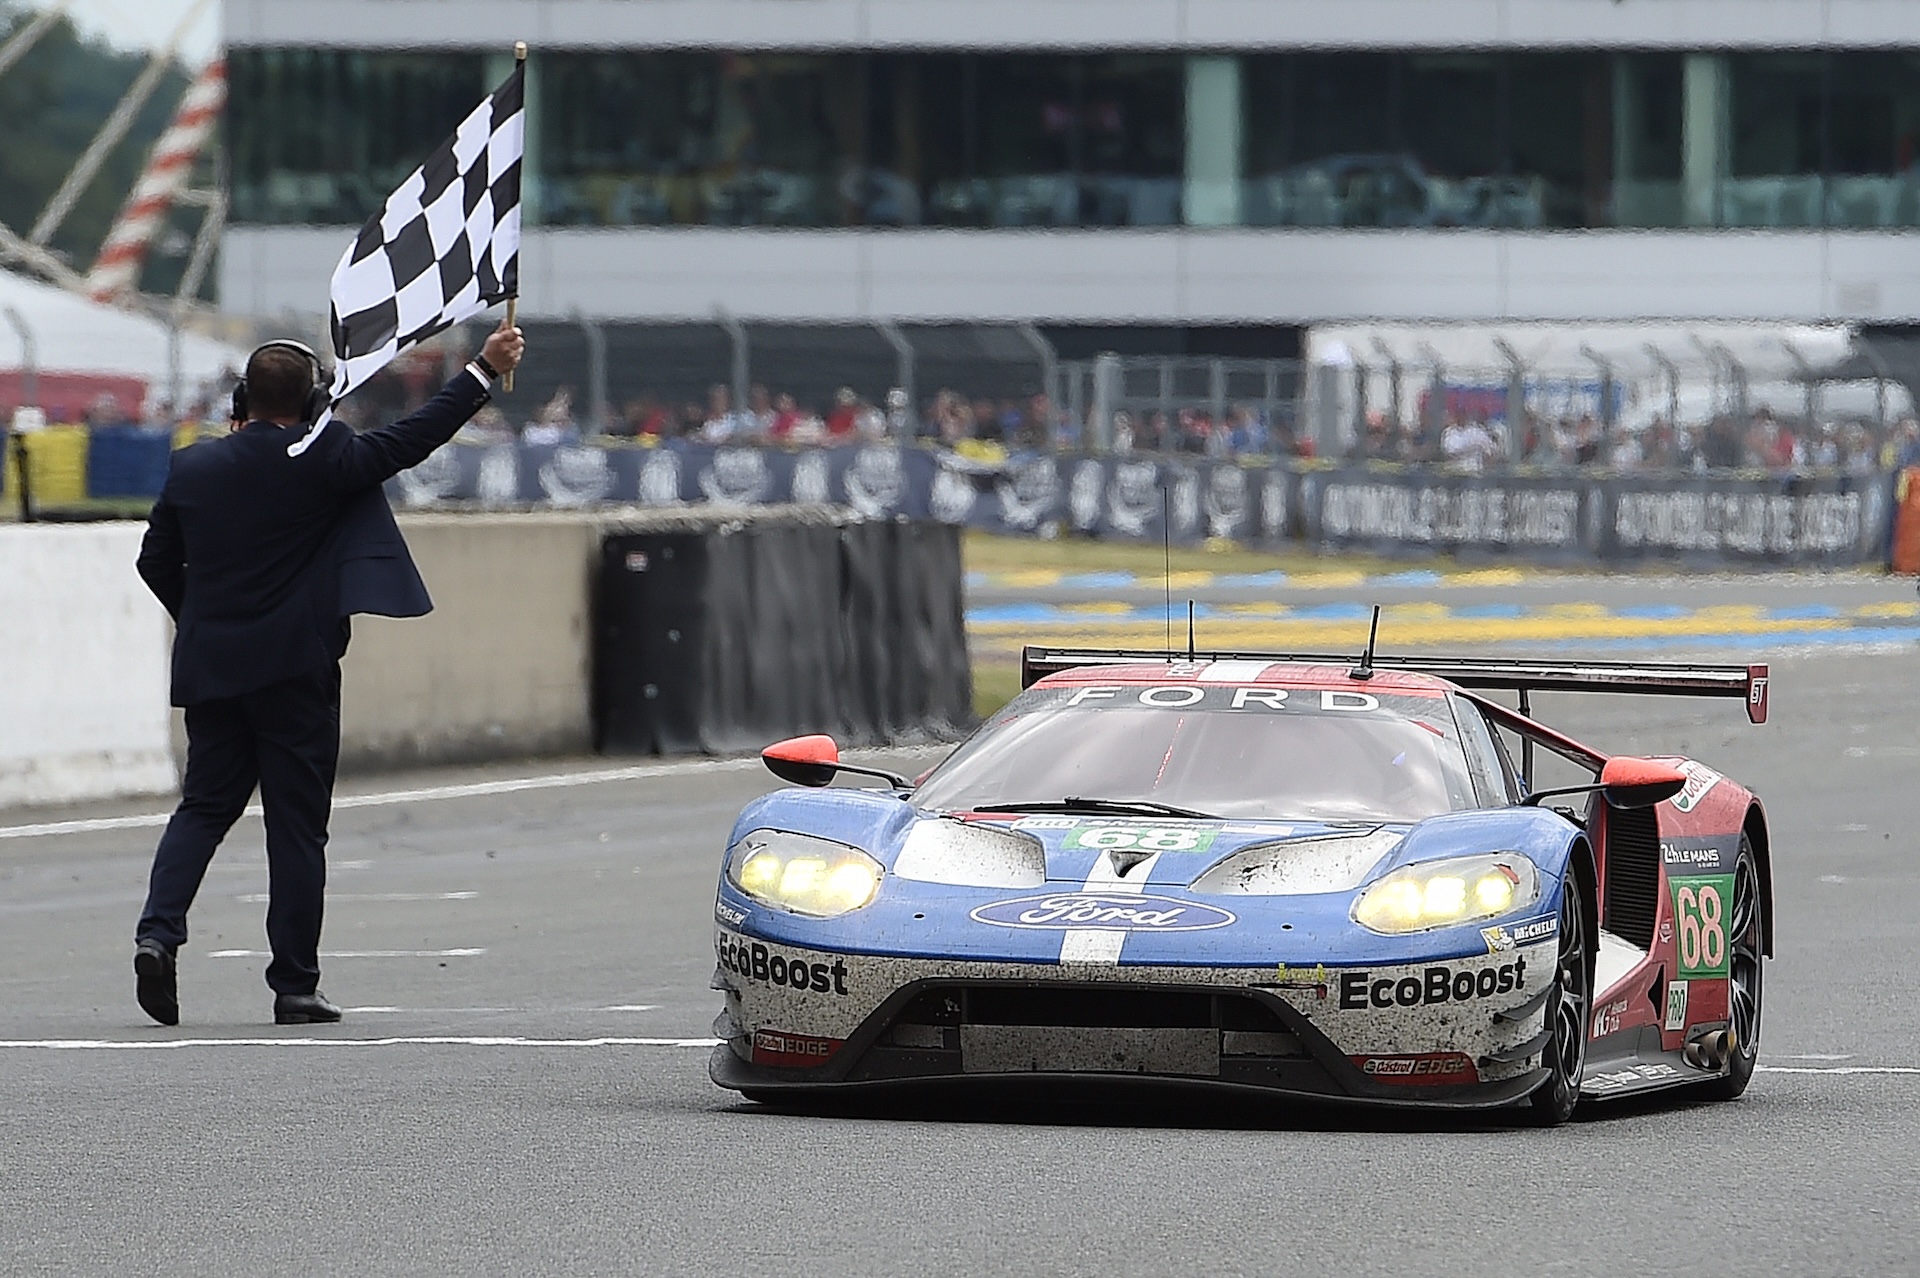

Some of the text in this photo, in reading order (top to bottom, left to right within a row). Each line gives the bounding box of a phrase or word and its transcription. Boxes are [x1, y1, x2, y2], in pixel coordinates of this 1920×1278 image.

[1067, 686, 1381, 712] FORD
[1078, 826, 1201, 850] 68
[1690, 849, 1720, 862] MANS
[1018, 897, 1187, 927] Ford
[1677, 885, 1726, 970] 68
[719, 931, 849, 997] EcoBoost
[1339, 954, 1527, 1011] EcoBoost
[1668, 988, 1686, 1023] PRO
[785, 1038, 830, 1057] EDGE
[1375, 1060, 1412, 1074] Castrol
